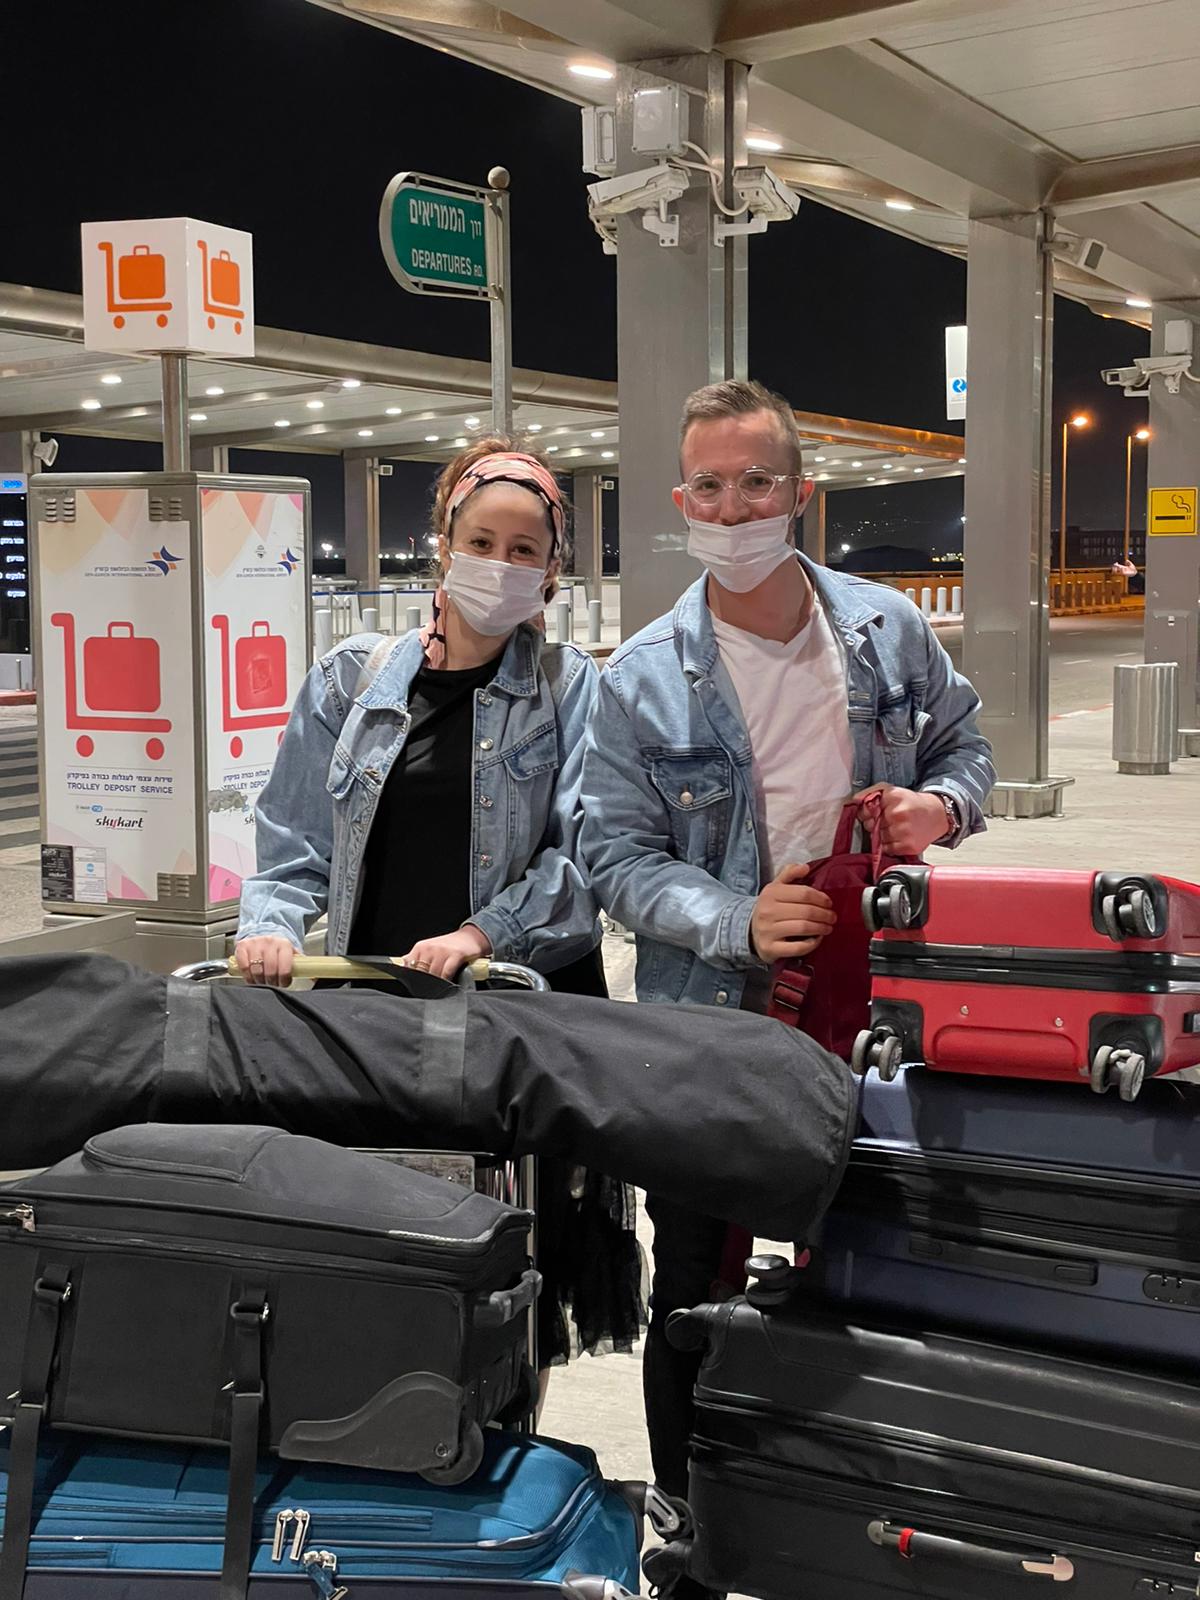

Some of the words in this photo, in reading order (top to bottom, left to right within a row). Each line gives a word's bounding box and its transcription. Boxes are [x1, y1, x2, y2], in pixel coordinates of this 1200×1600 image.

[409, 198, 465, 233] הממריאים
[470, 219, 482, 240] דרך
[411, 248, 472, 276] DEPARTURES
[67, 782, 101, 791] TROLLEY
[104, 784, 137, 792] DEPOSIT
[140, 785, 173, 794] SERVICE
[96, 816, 143, 829] skykart
